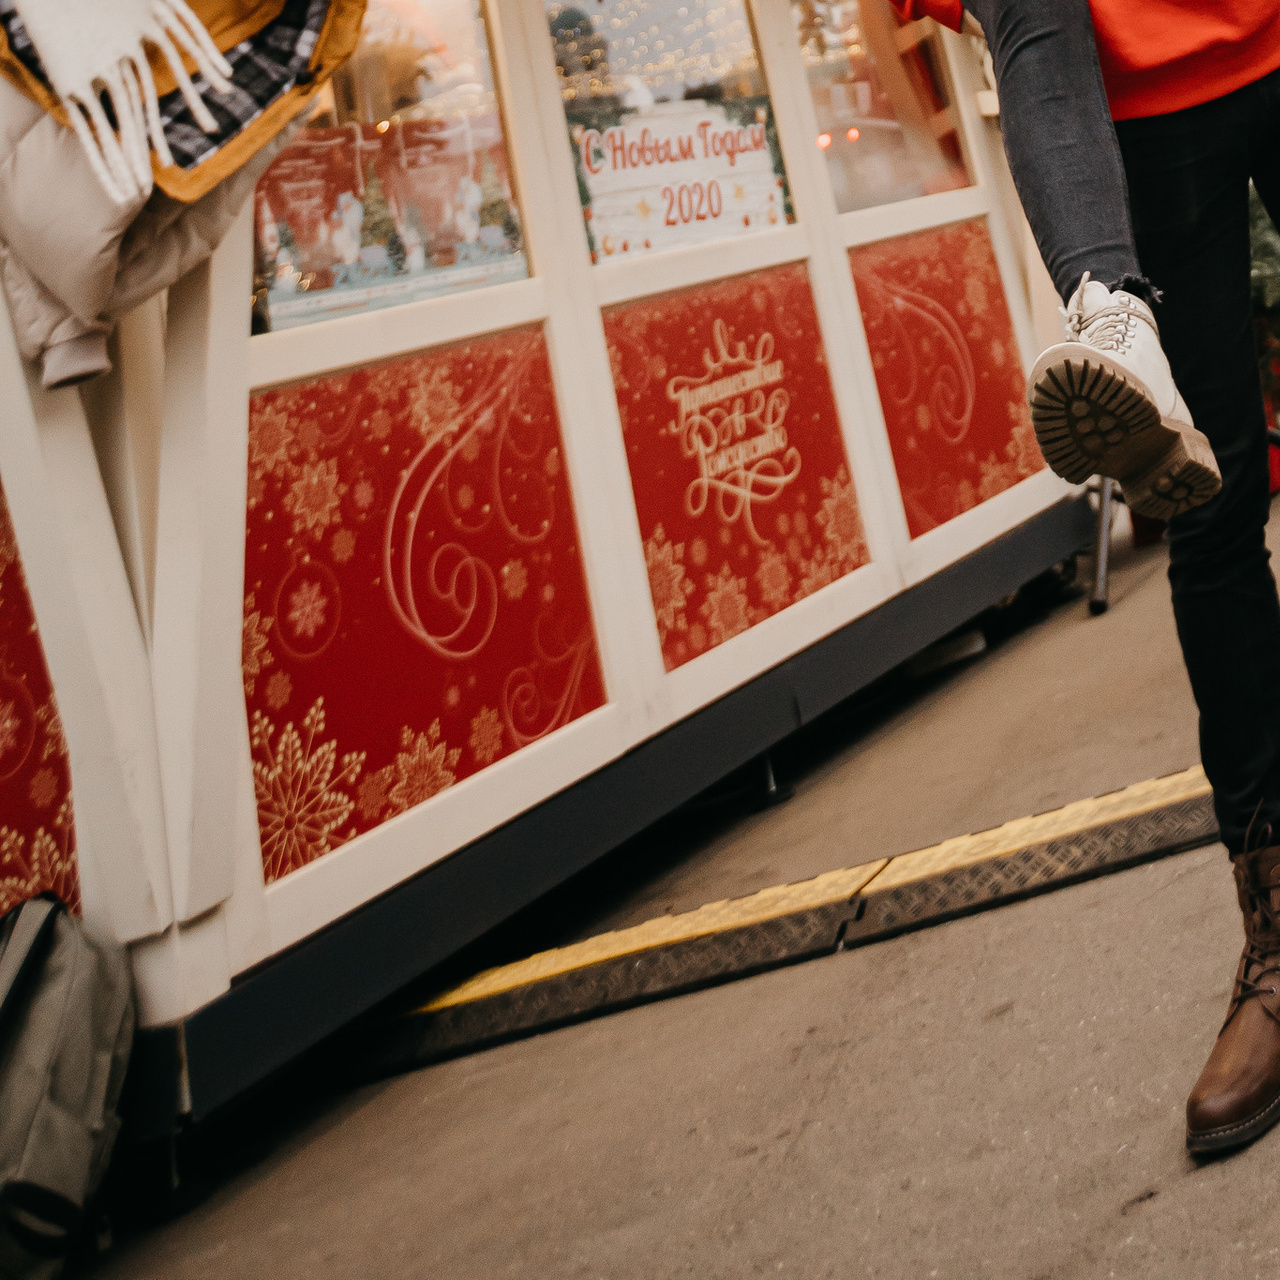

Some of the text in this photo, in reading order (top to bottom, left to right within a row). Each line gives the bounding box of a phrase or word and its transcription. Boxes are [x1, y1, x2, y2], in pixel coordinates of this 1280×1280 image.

[584, 120, 767, 174] С Новым Годом
[661, 179, 722, 226] 2020
